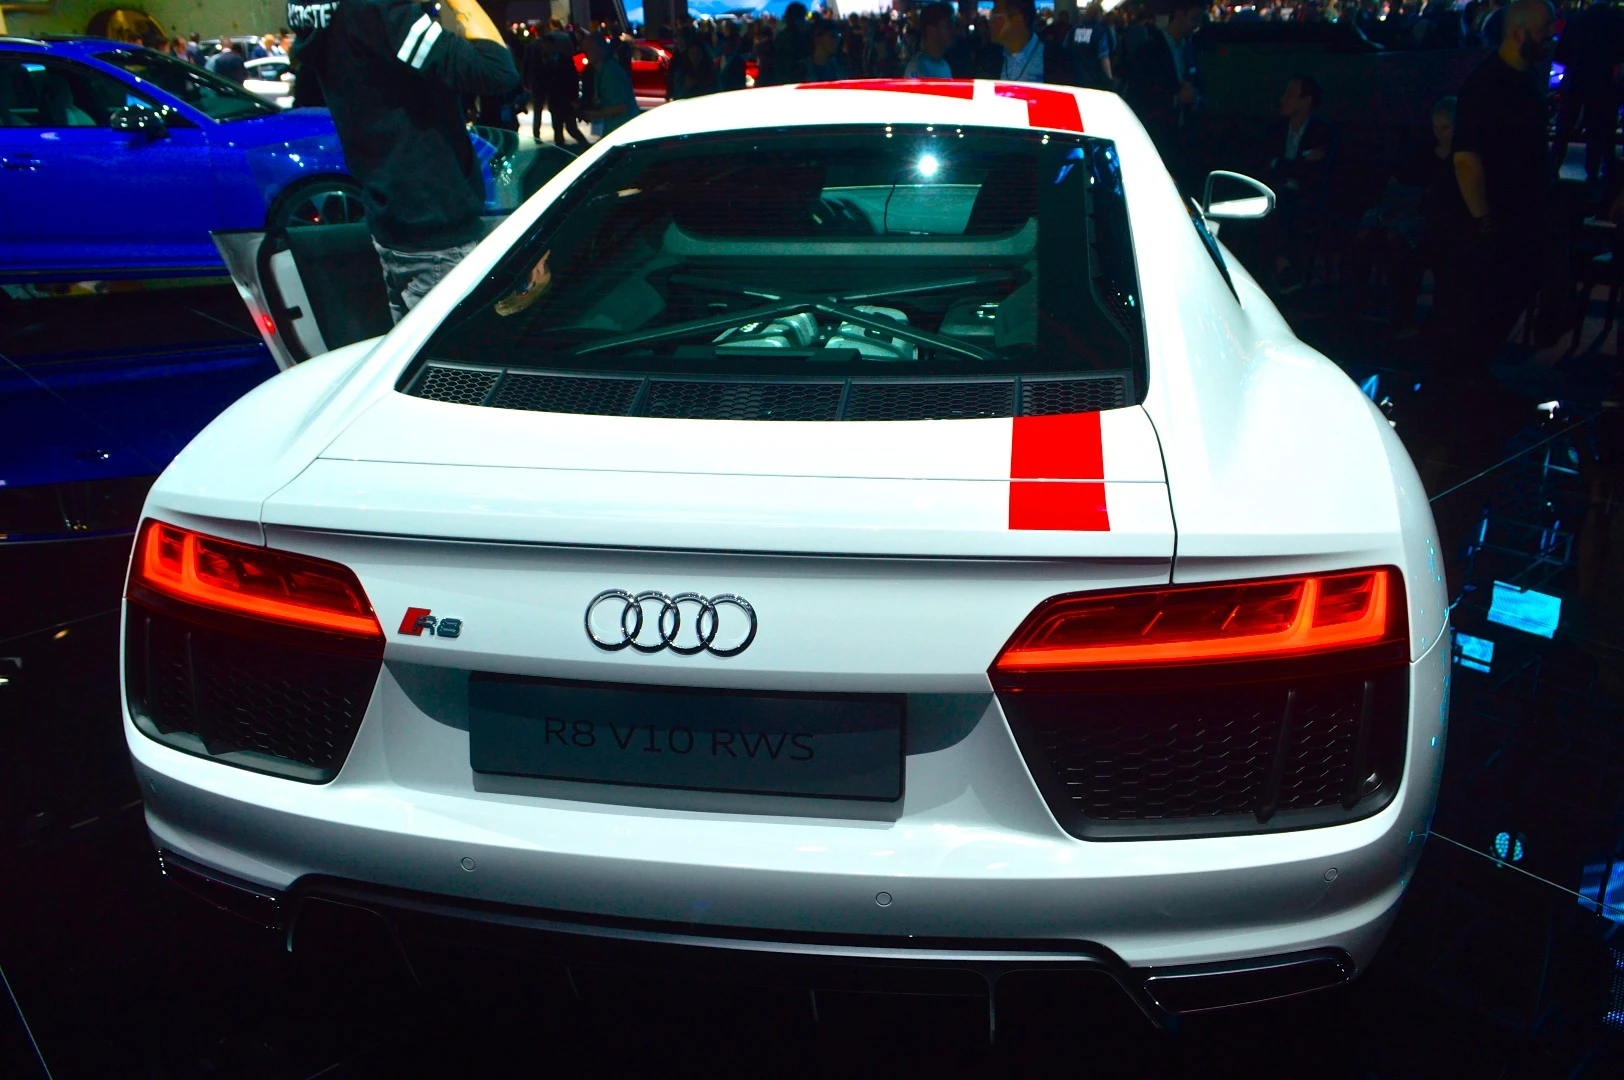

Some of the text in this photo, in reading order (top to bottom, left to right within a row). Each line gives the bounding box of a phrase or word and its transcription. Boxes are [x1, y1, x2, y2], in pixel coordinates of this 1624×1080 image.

[411, 614, 462, 639] R8
[544, 716, 815, 762] R8 V10 RWS
